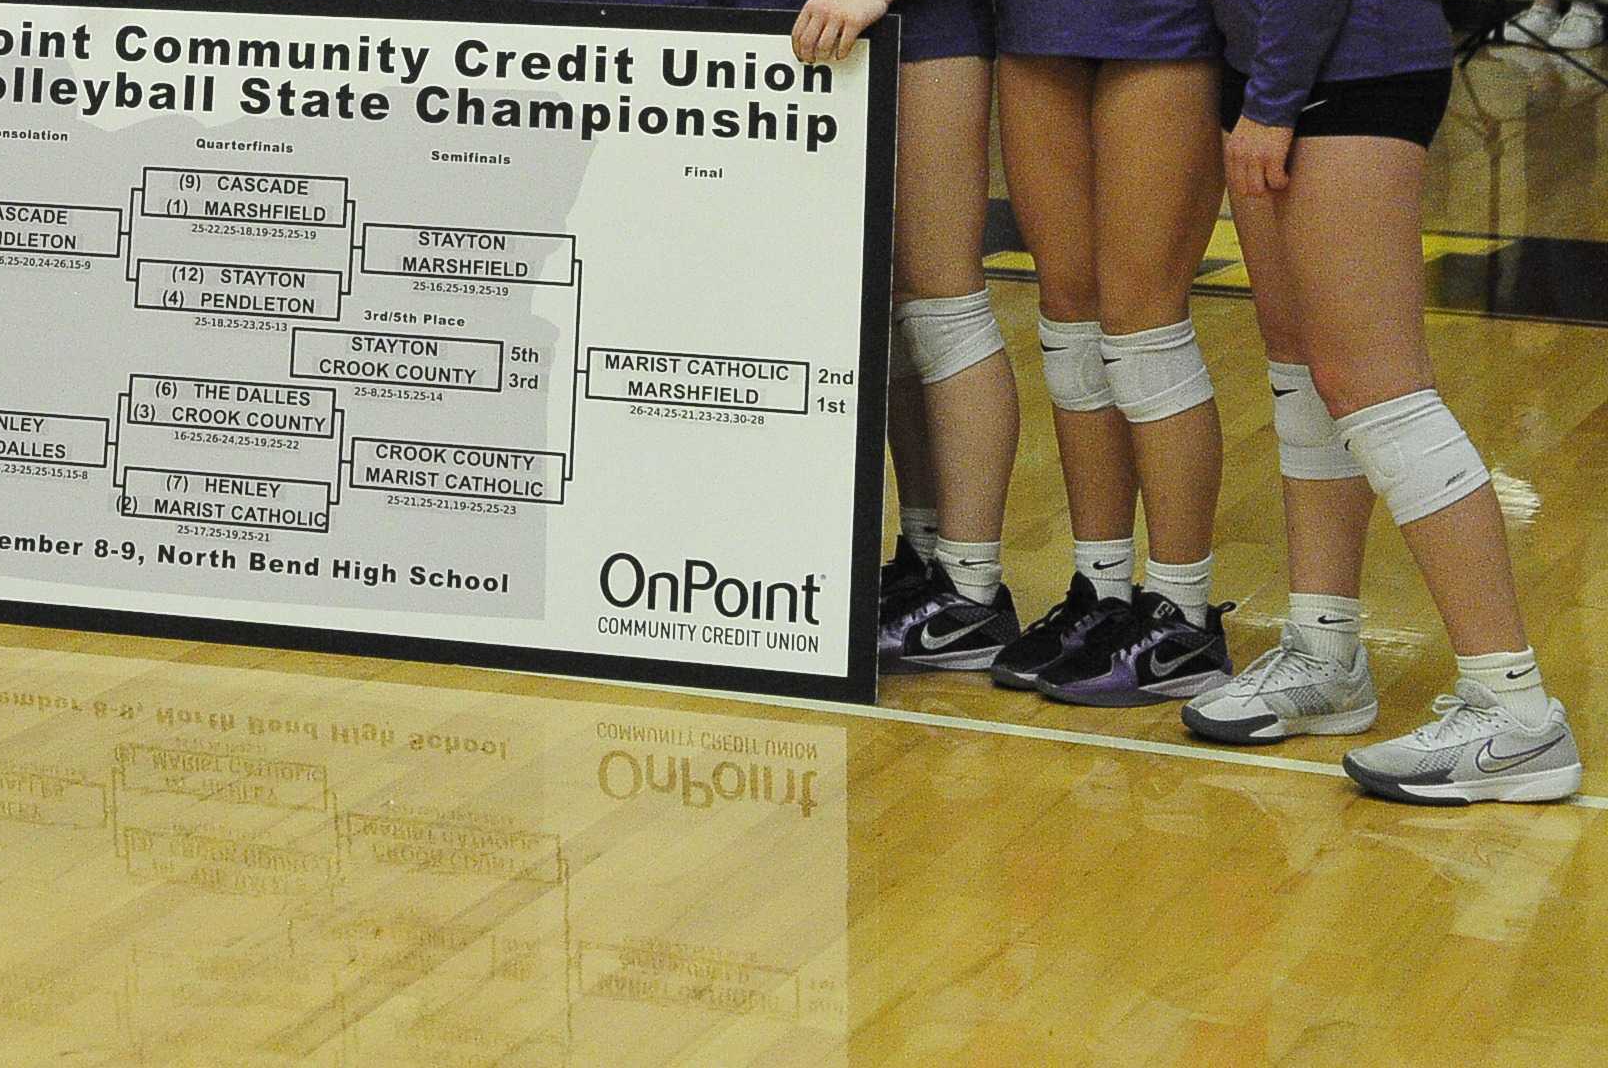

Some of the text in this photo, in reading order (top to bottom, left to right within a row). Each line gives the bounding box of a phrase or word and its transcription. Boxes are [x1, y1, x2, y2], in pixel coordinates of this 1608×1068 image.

[116, 26, 429, 84] Community
[455, 40, 633, 84] Credit
[662, 48, 833, 93] Union
[240, 78, 389, 120] State
[416, 86, 837, 152] Championship
[196, 139, 293, 153] Quarterfinals
[432, 151, 510, 164] Semifinals
[685, 167, 722, 178] Final
[180, 174, 309, 195] (9) CASCADE
[166, 199, 325, 221] (1) MARSHFIELD
[419, 231, 505, 250] STAYTON
[172, 266, 305, 288] (12) STAYTON
[403, 257, 528, 277] MARSHFIELD
[413, 281, 508, 296] 25-16,25-19,25-19
[162, 290, 314, 314] (4) PENDLETON
[195, 317, 287, 331] 25-18,25-23,25-13
[364, 310, 465, 326] 3rd/5th Place
[352, 337, 437, 356] STAYTON
[511, 346, 538, 363] 5th
[320, 359, 476, 384] CROOK COUNTY
[605, 354, 789, 380] MARIST CATHOLIC
[818, 369, 853, 385] 2nd
[509, 373, 538, 389] 3rd
[156, 381, 310, 406] (6) THE DALLES
[355, 387, 442, 401] 25-8,25-15,25-14
[628, 381, 758, 404] MARSHFIELD
[817, 397, 845, 413] 1st
[133, 404, 326, 432] (3) CROOK COUNTY
[175, 431, 299, 449] 16-25,26-24,25-19,25-22
[376, 444, 535, 471] CROOK COUNTY
[167, 475, 281, 498] (7) HENLEY
[366, 467, 543, 497] MARIST CATHOLIC
[155, 499, 225, 518] MARIST
[231, 505, 327, 527] CATHOLIC
[387, 495, 516, 515] 25-21,25-21,19-25,25-23
[177, 525, 269, 542] 25-17,25-19,25-21
[95, 539, 144, 565] 8-9,
[158, 545, 235, 569] North
[250, 552, 319, 576] Bend
[333, 559, 396, 586] High
[409, 566, 508, 592] School
[600, 552, 821, 626] OnPoint
[598, 617, 818, 653] COMMUNITY CREDIT UNION
